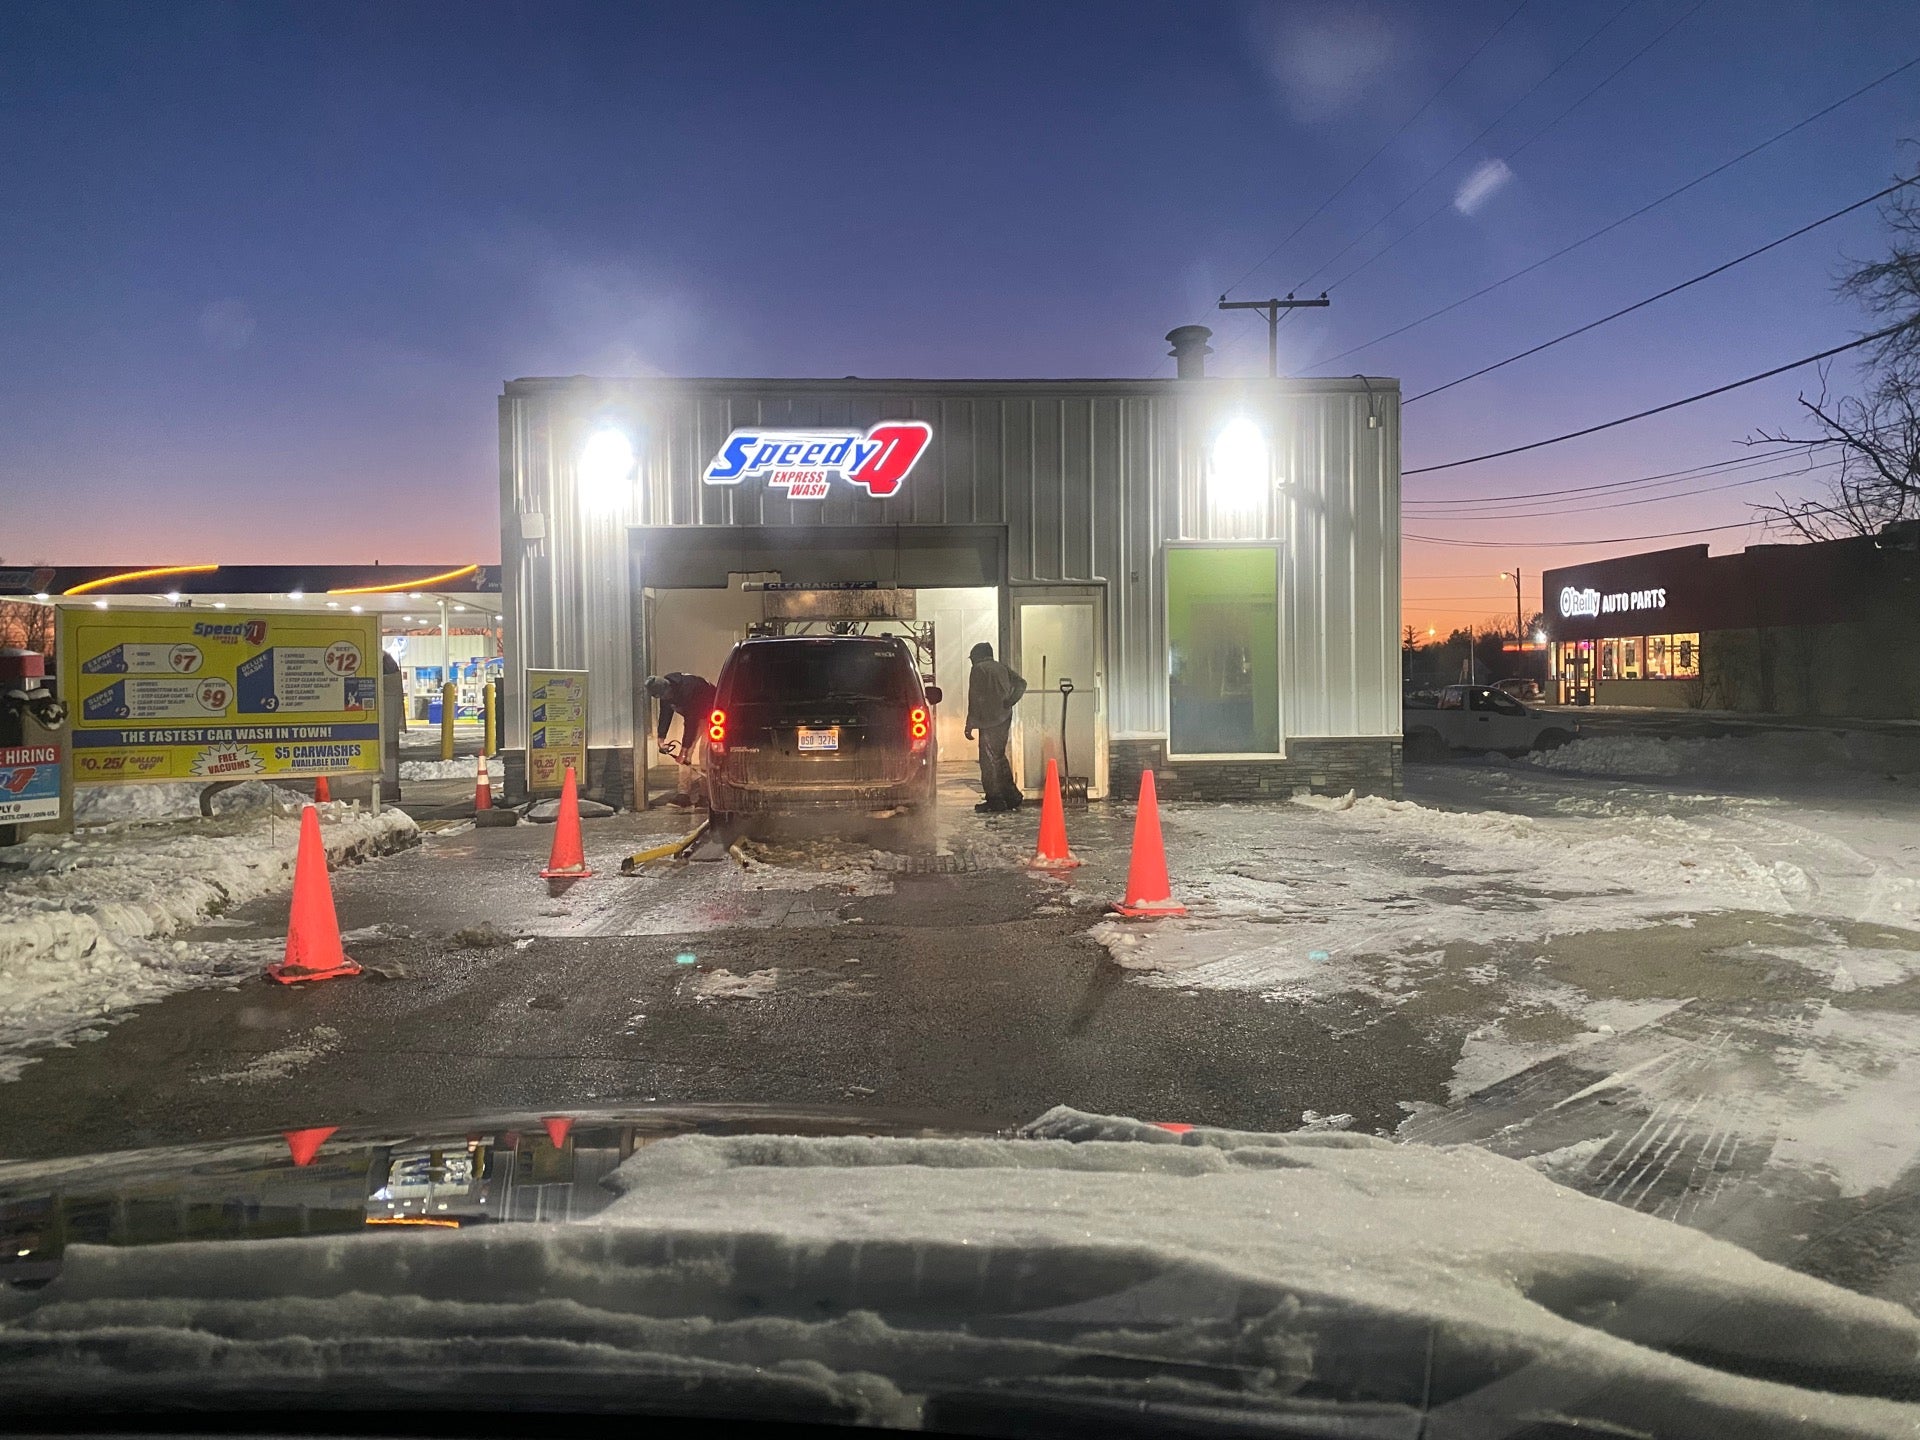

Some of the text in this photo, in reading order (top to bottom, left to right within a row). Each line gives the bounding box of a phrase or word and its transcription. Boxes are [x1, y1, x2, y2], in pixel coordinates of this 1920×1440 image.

[772, 471, 825, 484] EXPRESS
[790, 484, 827, 497] WASH
[768, 582, 847, 590] CLEARANCE
[1602, 592, 1629, 614] AUTO
[1630, 588, 1666, 610] PARTS
[173, 654, 197, 672] $7
[241, 654, 268, 672] DELUXE
[326, 652, 358, 672] $12
[243, 663, 264, 678] WASH
[87, 689, 115, 706] SUPER
[90, 696, 113, 711] WASH
[202, 689, 226, 708] $9
[120, 726, 332, 743] THE FASTEST CAR WASH IN TOWN!
[818, 735, 836, 745] 3276
[5, 747, 55, 765] HIRING
[129, 755, 164, 764] GALLON
[217, 752, 238, 764] FREE
[274, 744, 361, 760] $5 CARWASHES
[138, 762, 156, 771] OFF
[207, 759, 251, 775] VACUUMS
[291, 757, 350, 768] AVAILABLE DAILY
